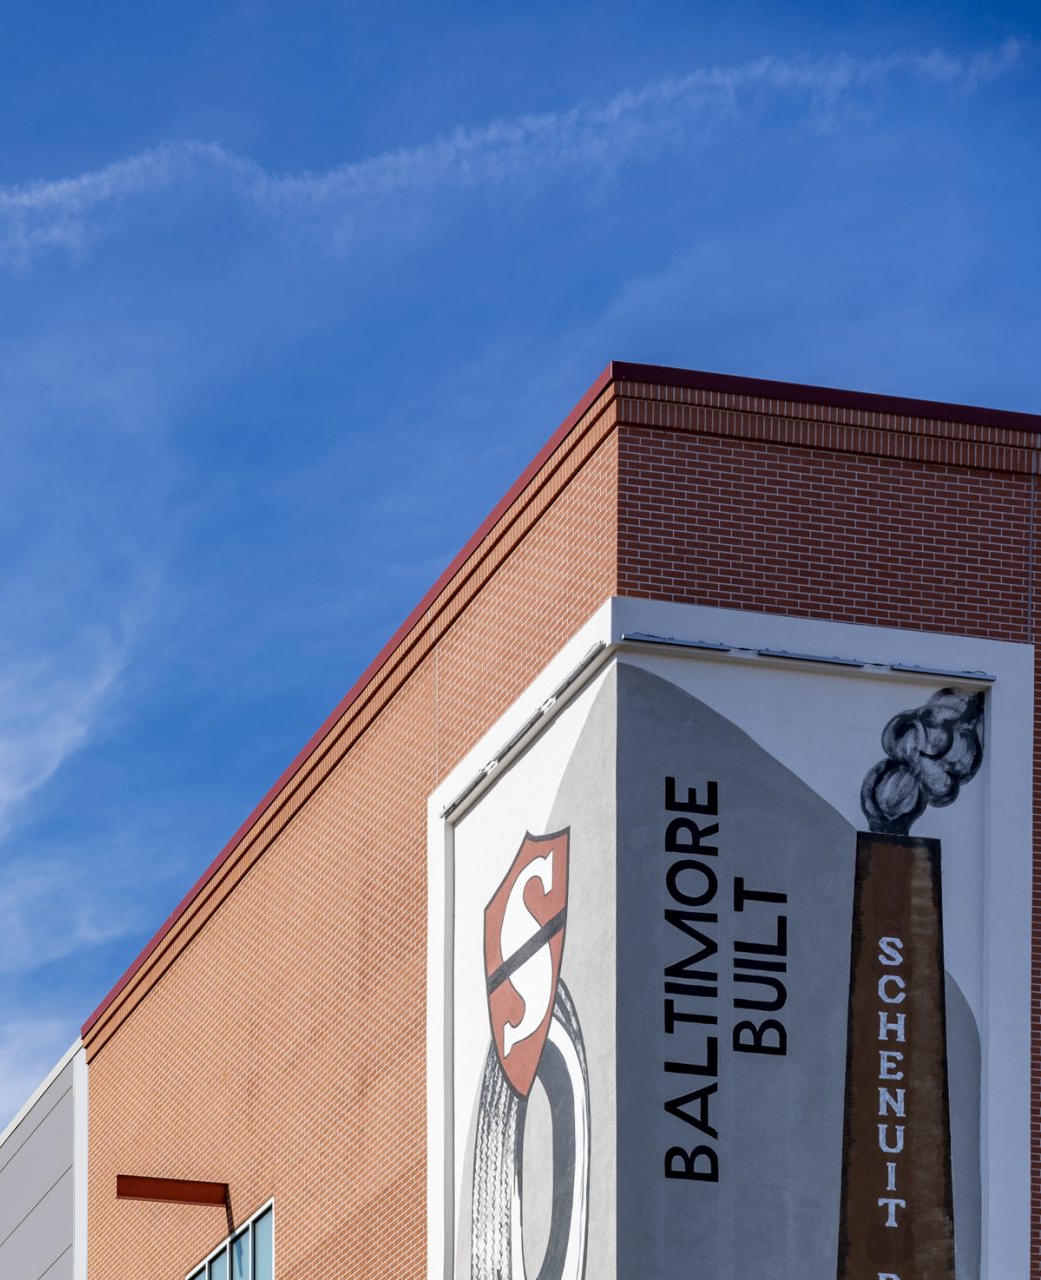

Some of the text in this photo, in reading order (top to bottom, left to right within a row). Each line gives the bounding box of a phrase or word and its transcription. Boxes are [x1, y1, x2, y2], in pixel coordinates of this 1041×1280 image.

[664, 776, 719, 1183] BALTIMORE
[733, 876, 788, 1056] BUILT
[877, 936, 907, 1228] SCHENUIT
